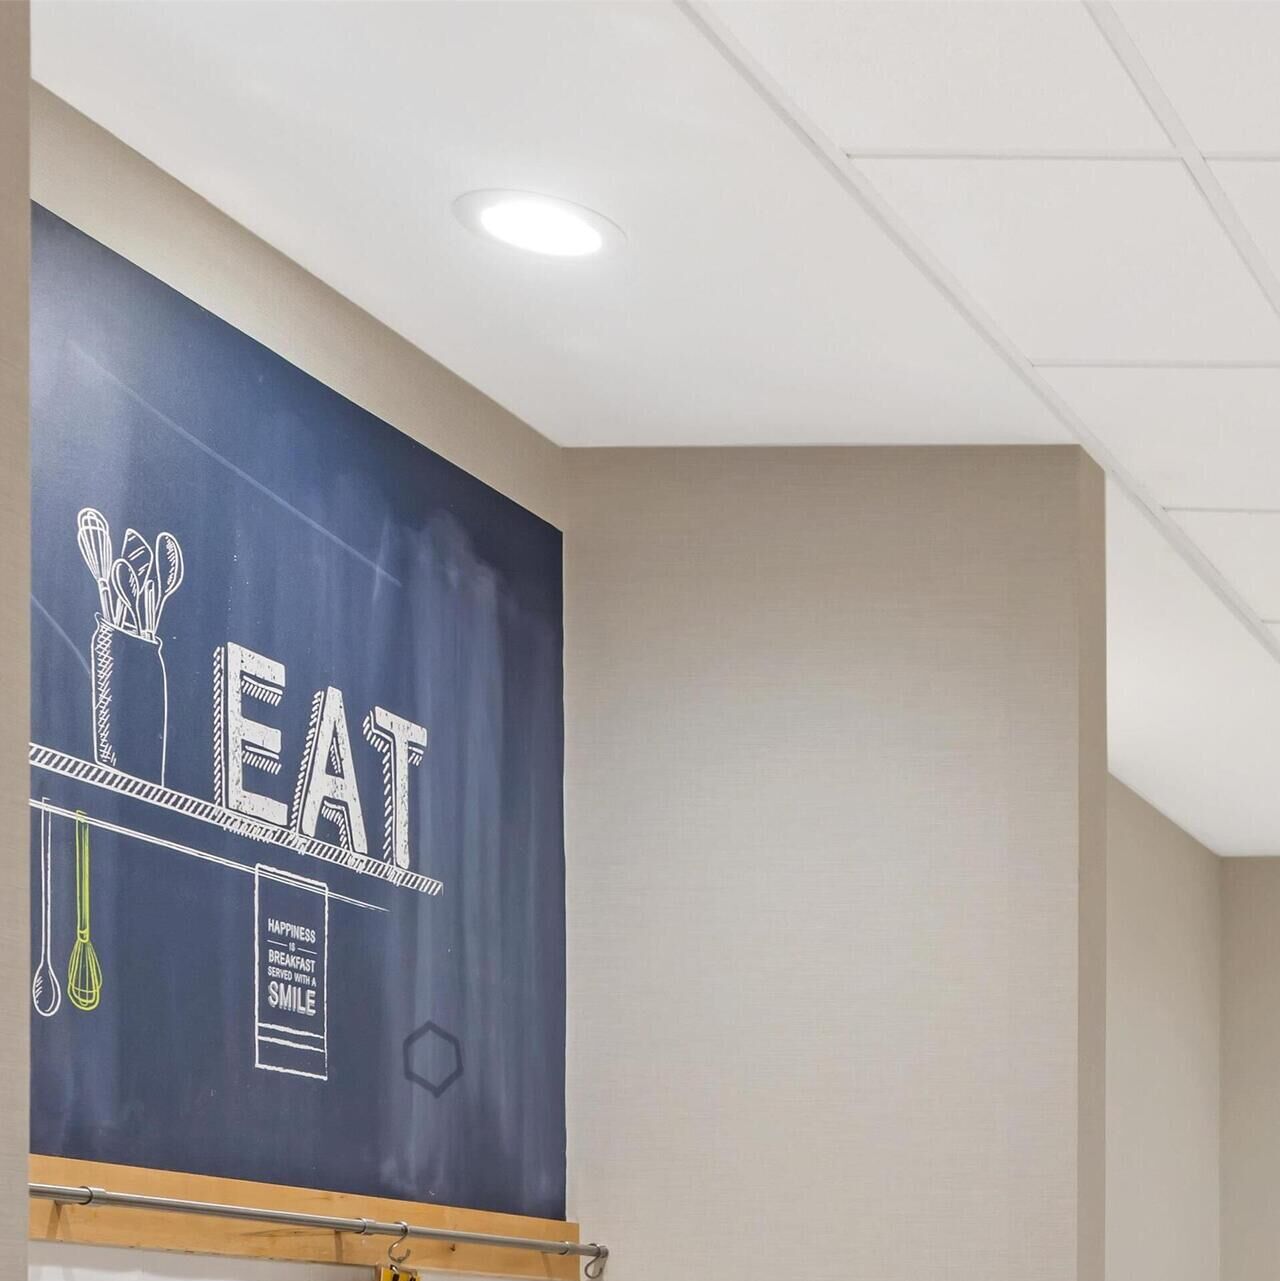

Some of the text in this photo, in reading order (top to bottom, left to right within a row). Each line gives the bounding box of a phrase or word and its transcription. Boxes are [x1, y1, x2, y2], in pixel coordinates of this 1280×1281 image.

[213, 641, 428, 870] EAT
[267, 918, 317, 943] HAPPINESS
[288, 942, 296, 952] IS
[268, 949, 316, 973] BREAKFAST
[267, 966, 317, 987] SERVED WITH A
[267, 981, 317, 1016] SMILE
